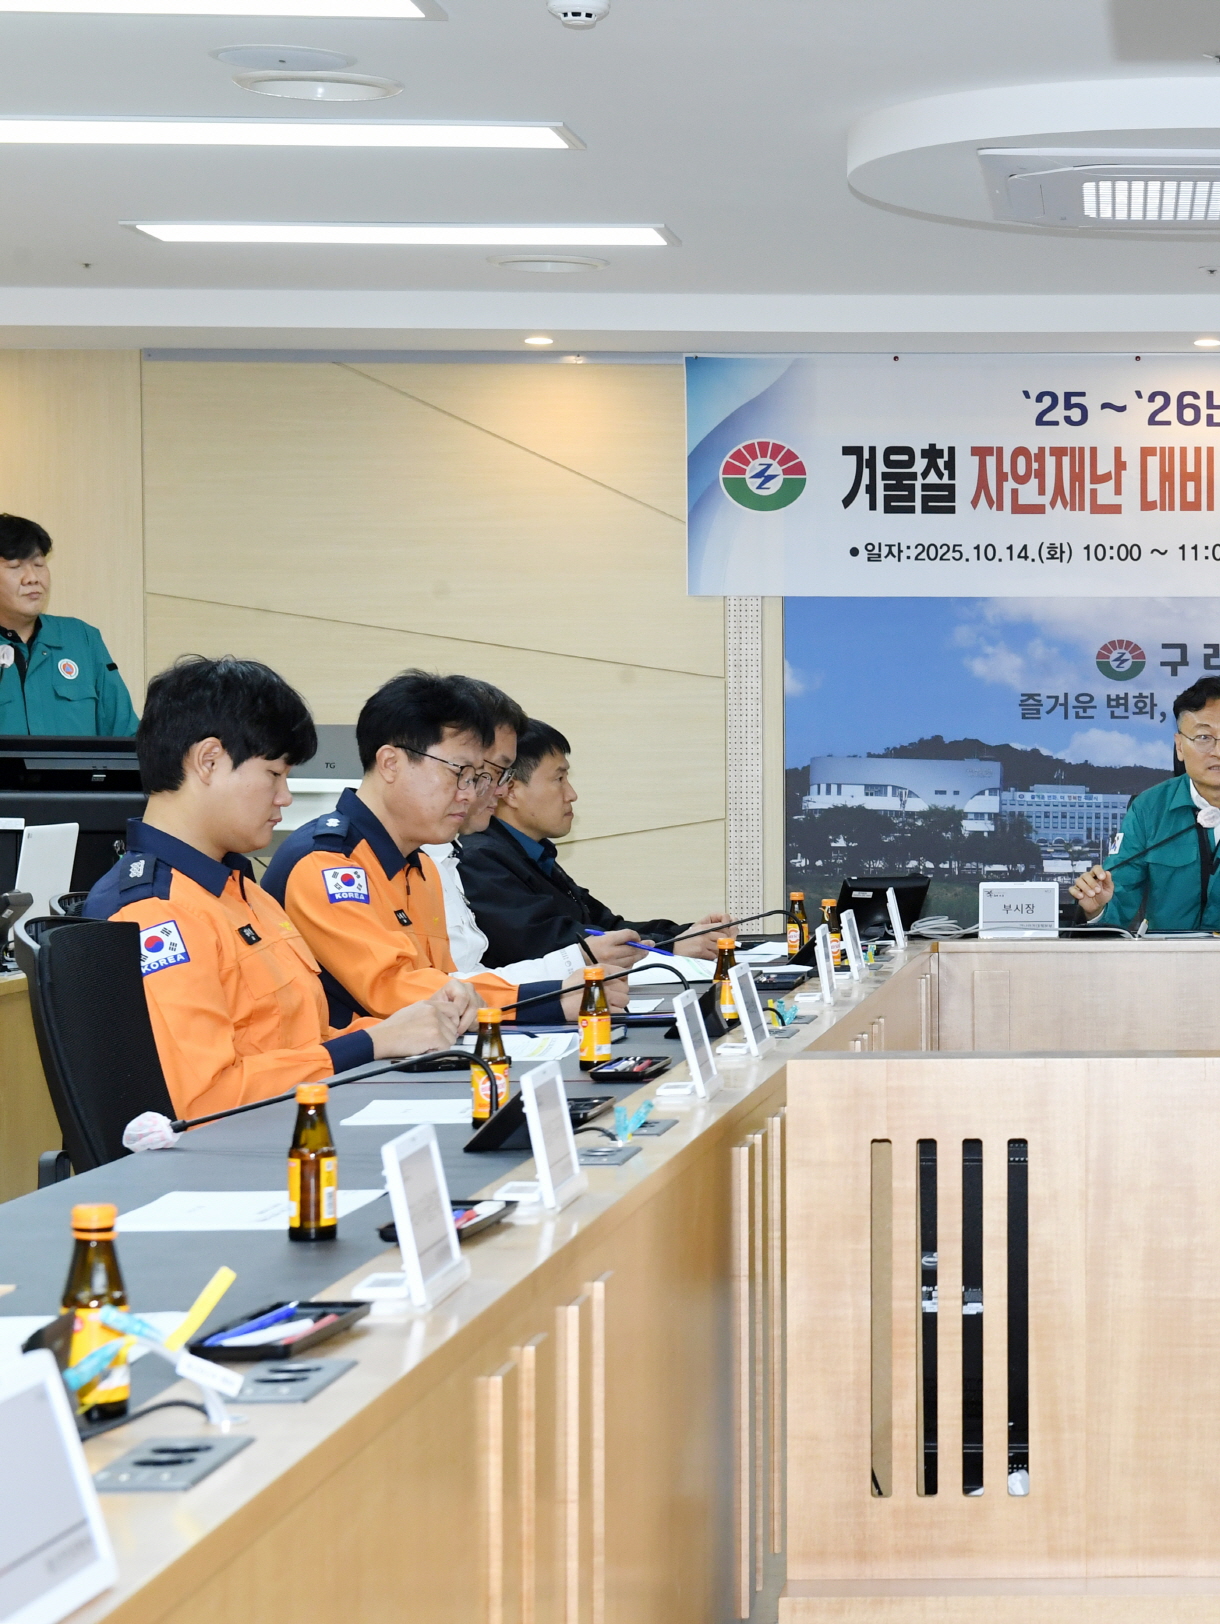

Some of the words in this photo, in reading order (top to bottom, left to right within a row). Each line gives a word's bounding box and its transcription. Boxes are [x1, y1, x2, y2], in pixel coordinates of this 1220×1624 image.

[841, 442, 956, 515] 겨울철
[970, 445, 1127, 515] 자연재난
[1140, 445, 1215, 513] 대비
[864, 541, 1073, 565] 일자:2025.10.14.(화)
[1083, 543, 1142, 562] 10:00
[1018, 692, 1098, 720] 즐거운
[1106, 692, 1167, 724] 변화,
[335, 891, 365, 901] KOREA
[1002, 903, 1036, 915] 부시장
[141, 953, 186, 974] KOREA
